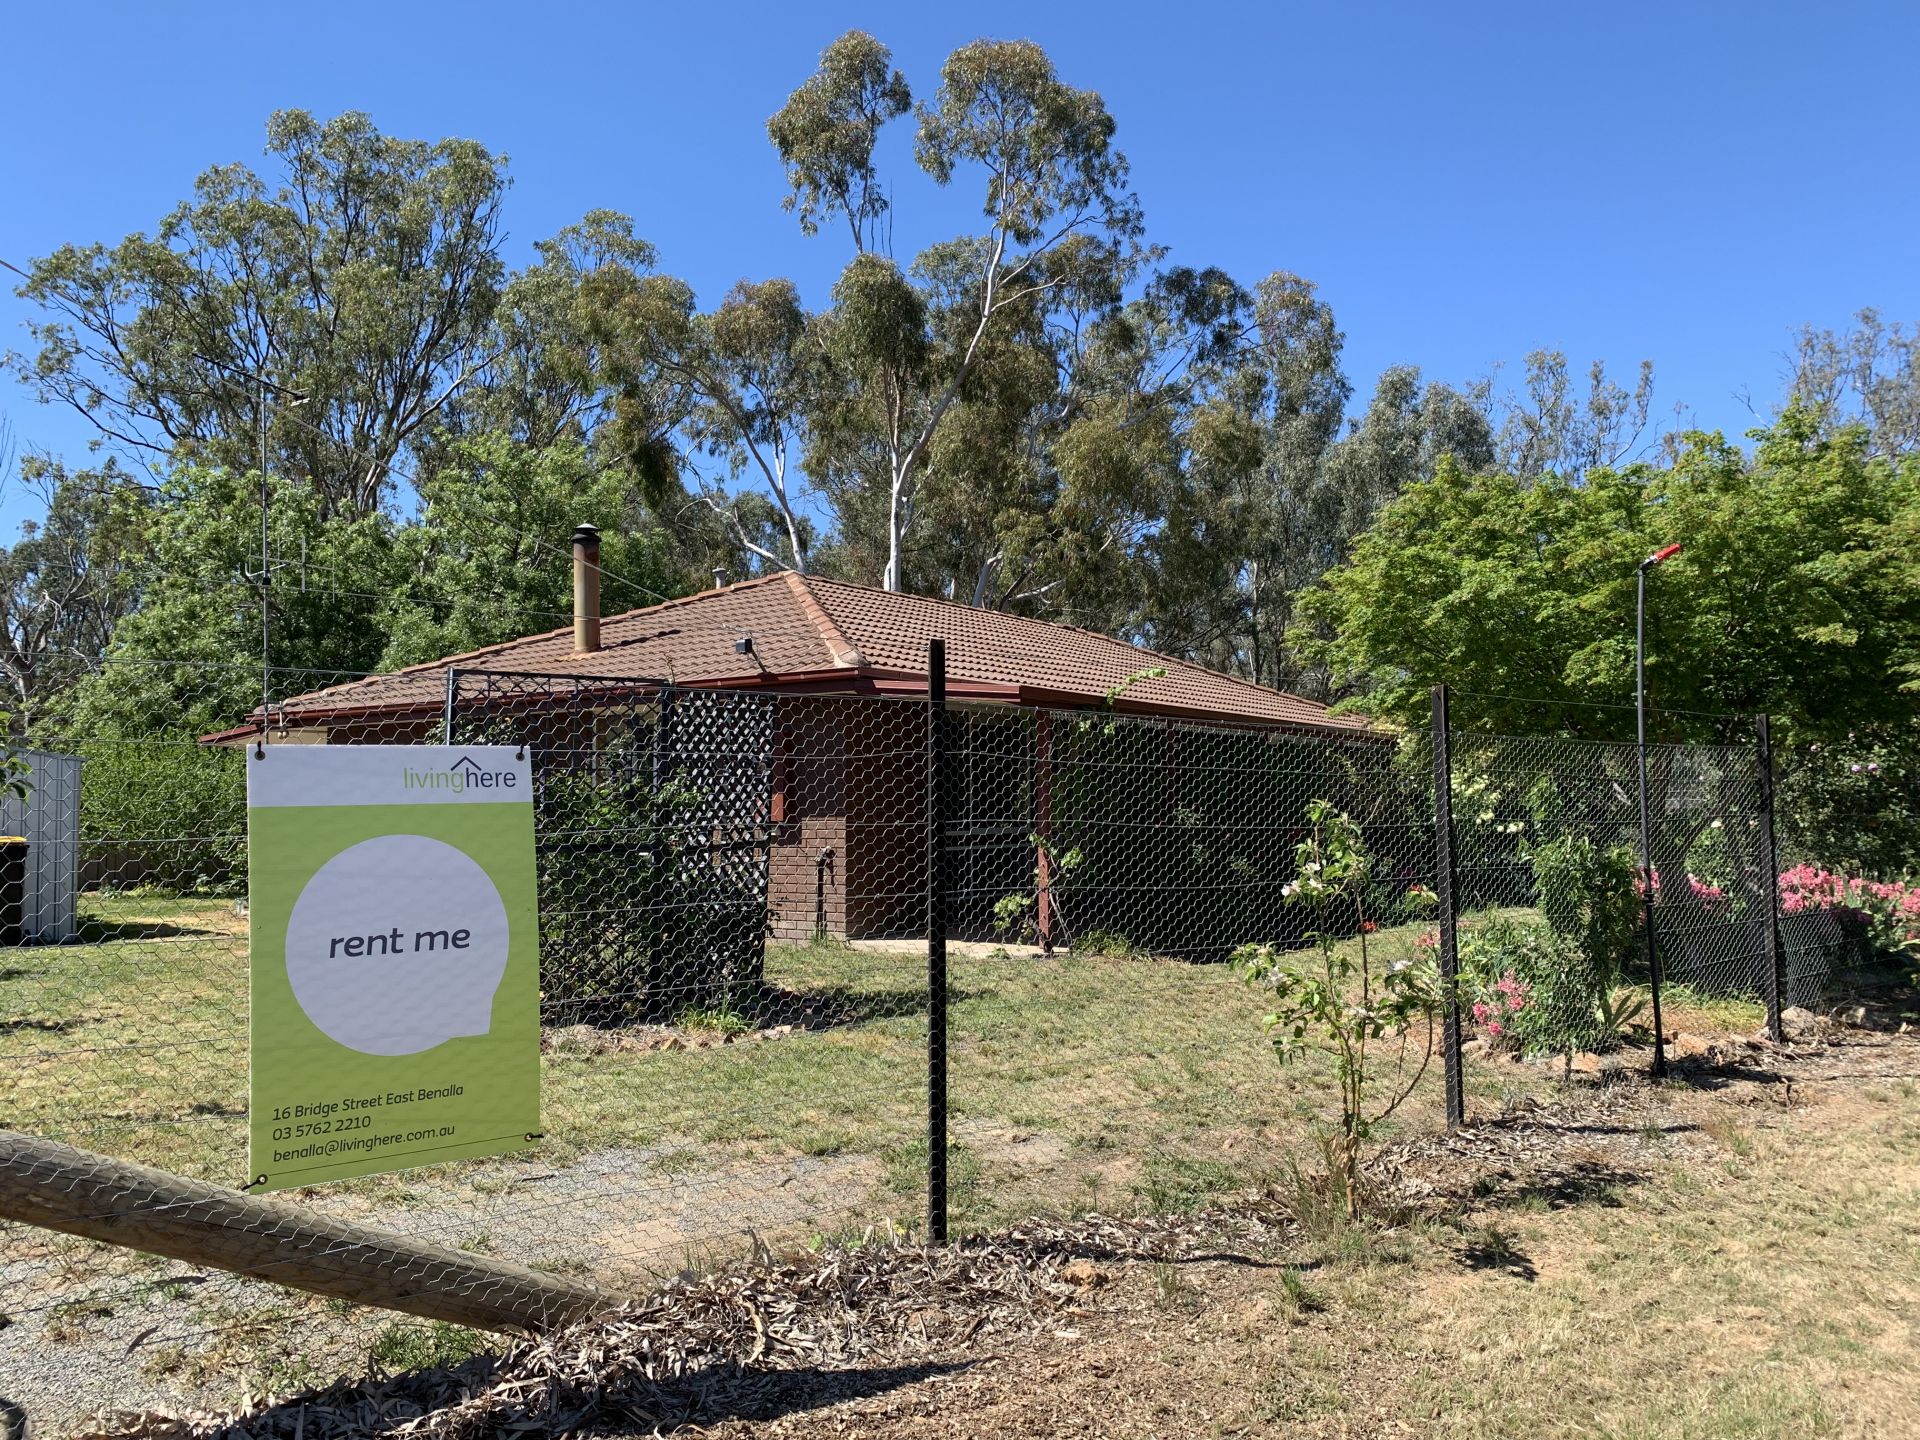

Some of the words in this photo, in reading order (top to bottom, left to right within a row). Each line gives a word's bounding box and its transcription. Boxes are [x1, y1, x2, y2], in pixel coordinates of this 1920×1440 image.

[403, 767, 517, 793] livinghere
[329, 927, 404, 958] rent
[414, 929, 471, 952] me
[272, 1106, 291, 1121] 16
[294, 1102, 338, 1118] Bridge
[342, 1094, 382, 1111] Street
[386, 1090, 415, 1105] East
[417, 1084, 464, 1101] Benalla
[272, 1127, 291, 1140] 03
[295, 1121, 331, 1138] 5762
[335, 1115, 371, 1132] 2210
[273, 1125, 455, 1162] benalla@livinghere.com.au
